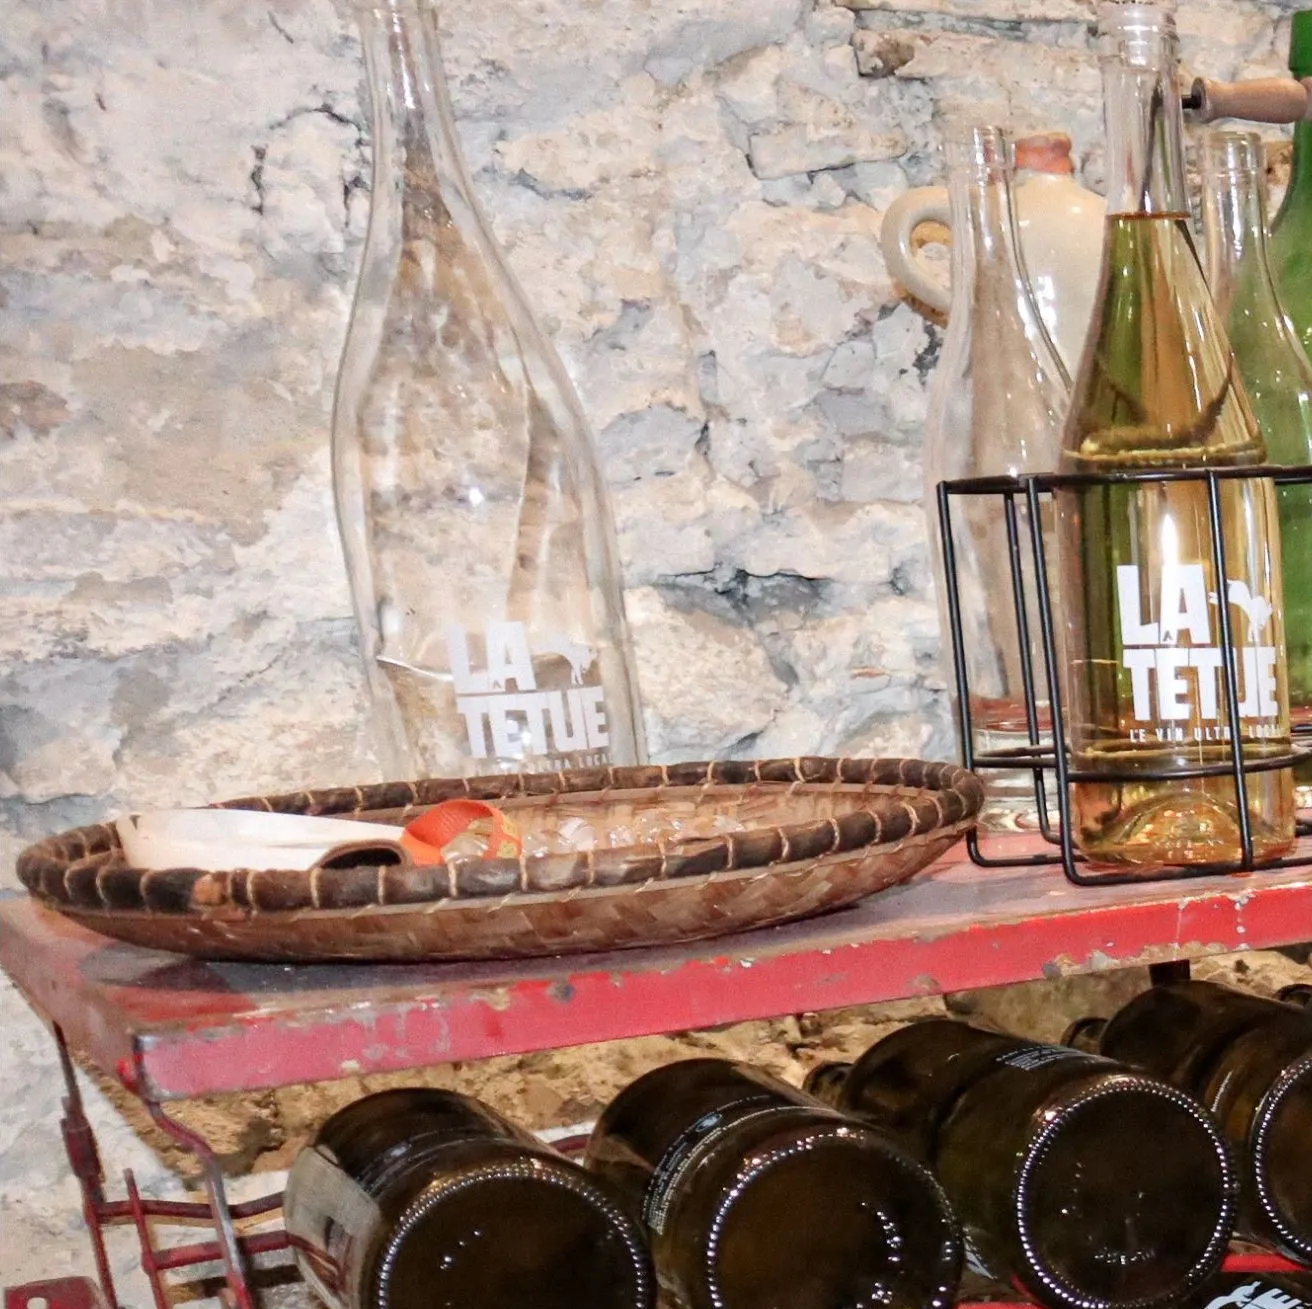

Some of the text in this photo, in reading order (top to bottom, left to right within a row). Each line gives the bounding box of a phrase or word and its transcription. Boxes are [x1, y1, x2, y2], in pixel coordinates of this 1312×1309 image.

[1117, 564, 1211, 645] LA
[447, 621, 537, 693] LA
[456, 685, 609, 759] TETUE
[1130, 728, 1146, 742] LE
[1156, 727, 1183, 742] VIN
[1194, 726, 1232, 742] ULTR
